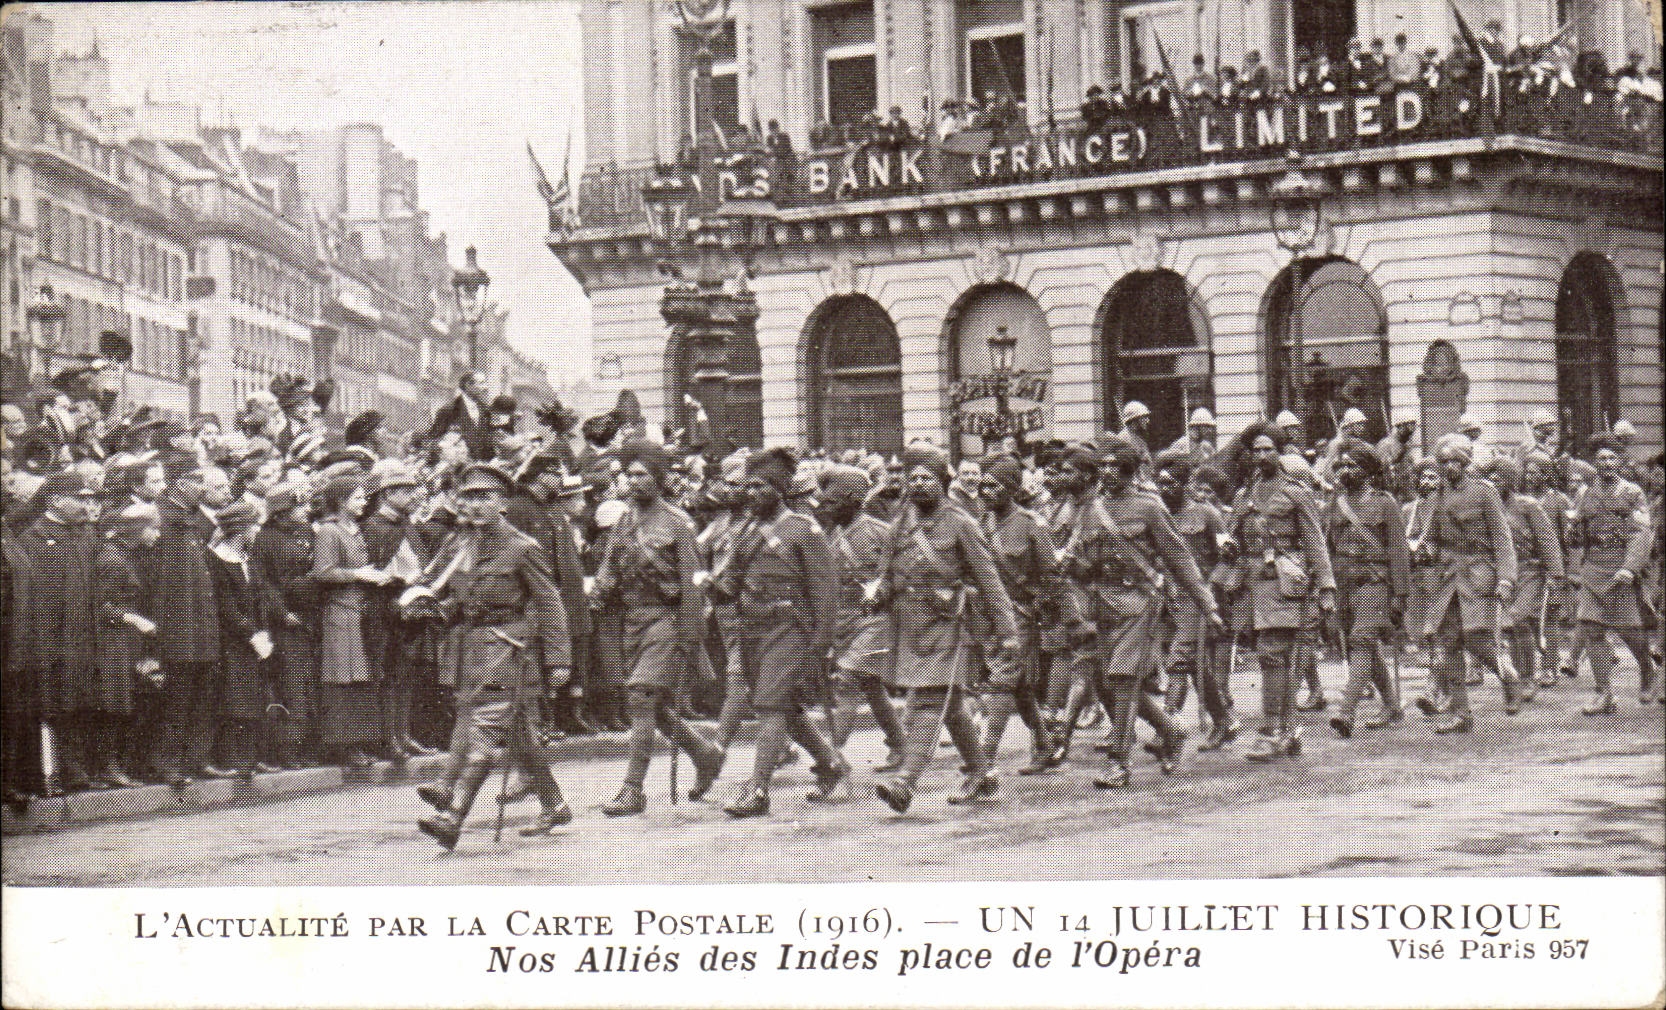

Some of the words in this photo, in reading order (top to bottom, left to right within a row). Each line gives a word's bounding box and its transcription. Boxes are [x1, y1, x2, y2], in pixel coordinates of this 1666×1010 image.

[809, 150, 923, 200] BANK
[971, 127, 1147, 178] (FRANCE)
[1199, 91, 1422, 152] LIMITED
